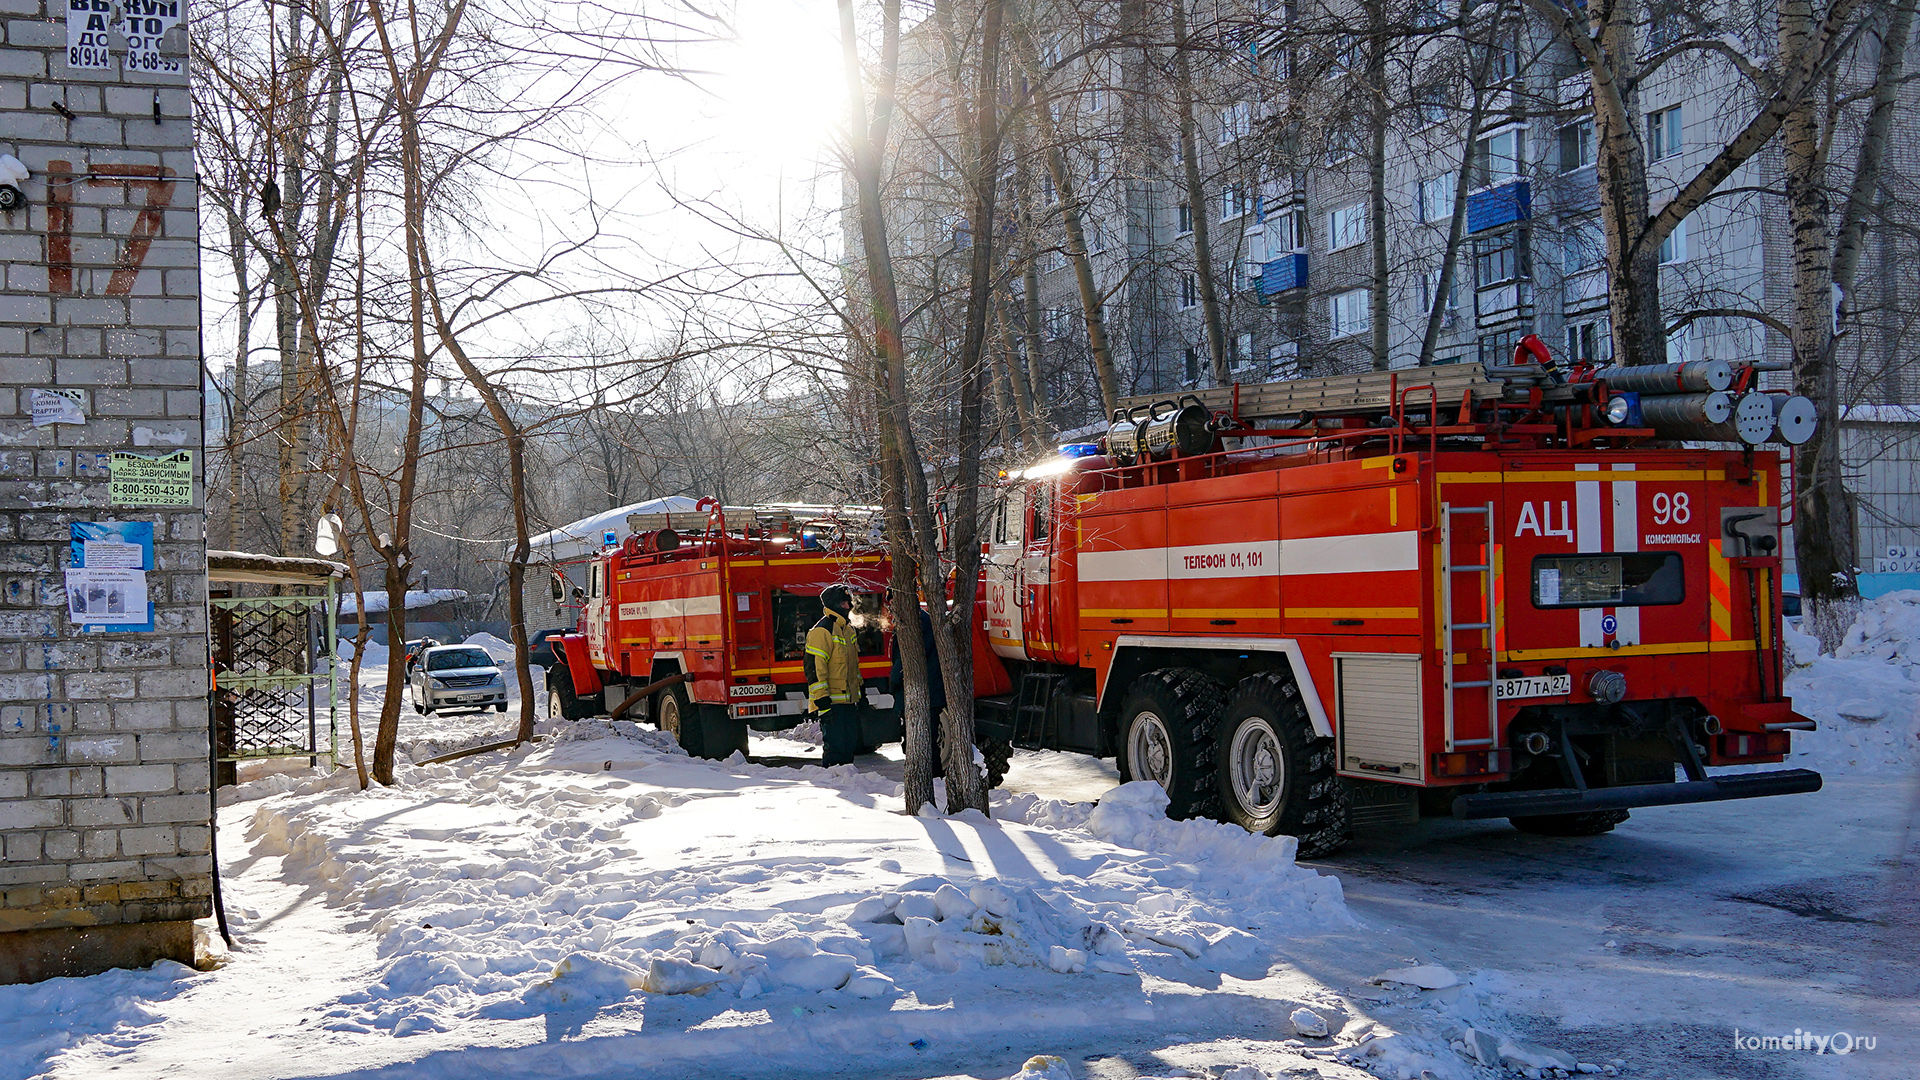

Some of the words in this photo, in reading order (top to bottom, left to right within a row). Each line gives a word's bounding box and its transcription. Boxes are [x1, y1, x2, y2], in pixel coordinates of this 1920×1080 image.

[47, 160, 177, 296] 17
[127, 461, 177, 470] БЕЗДОМНЫМ
[139, 468, 190, 479] ЗАВИСИМЫМ
[112, 483, 190, 496] 8-800-550-43-07
[1652, 492, 1690, 525] 98
[1514, 501, 1573, 543] АЦ
[1645, 534, 1701, 544] КОМСОМОЛЬСК
[1183, 553, 1226, 570] ТЕЛЕФОН
[1230, 552, 1244, 570] 01,
[1246, 551, 1263, 567] 101
[992, 585, 1005, 614] 98
[1553, 677, 1566, 689] 27
